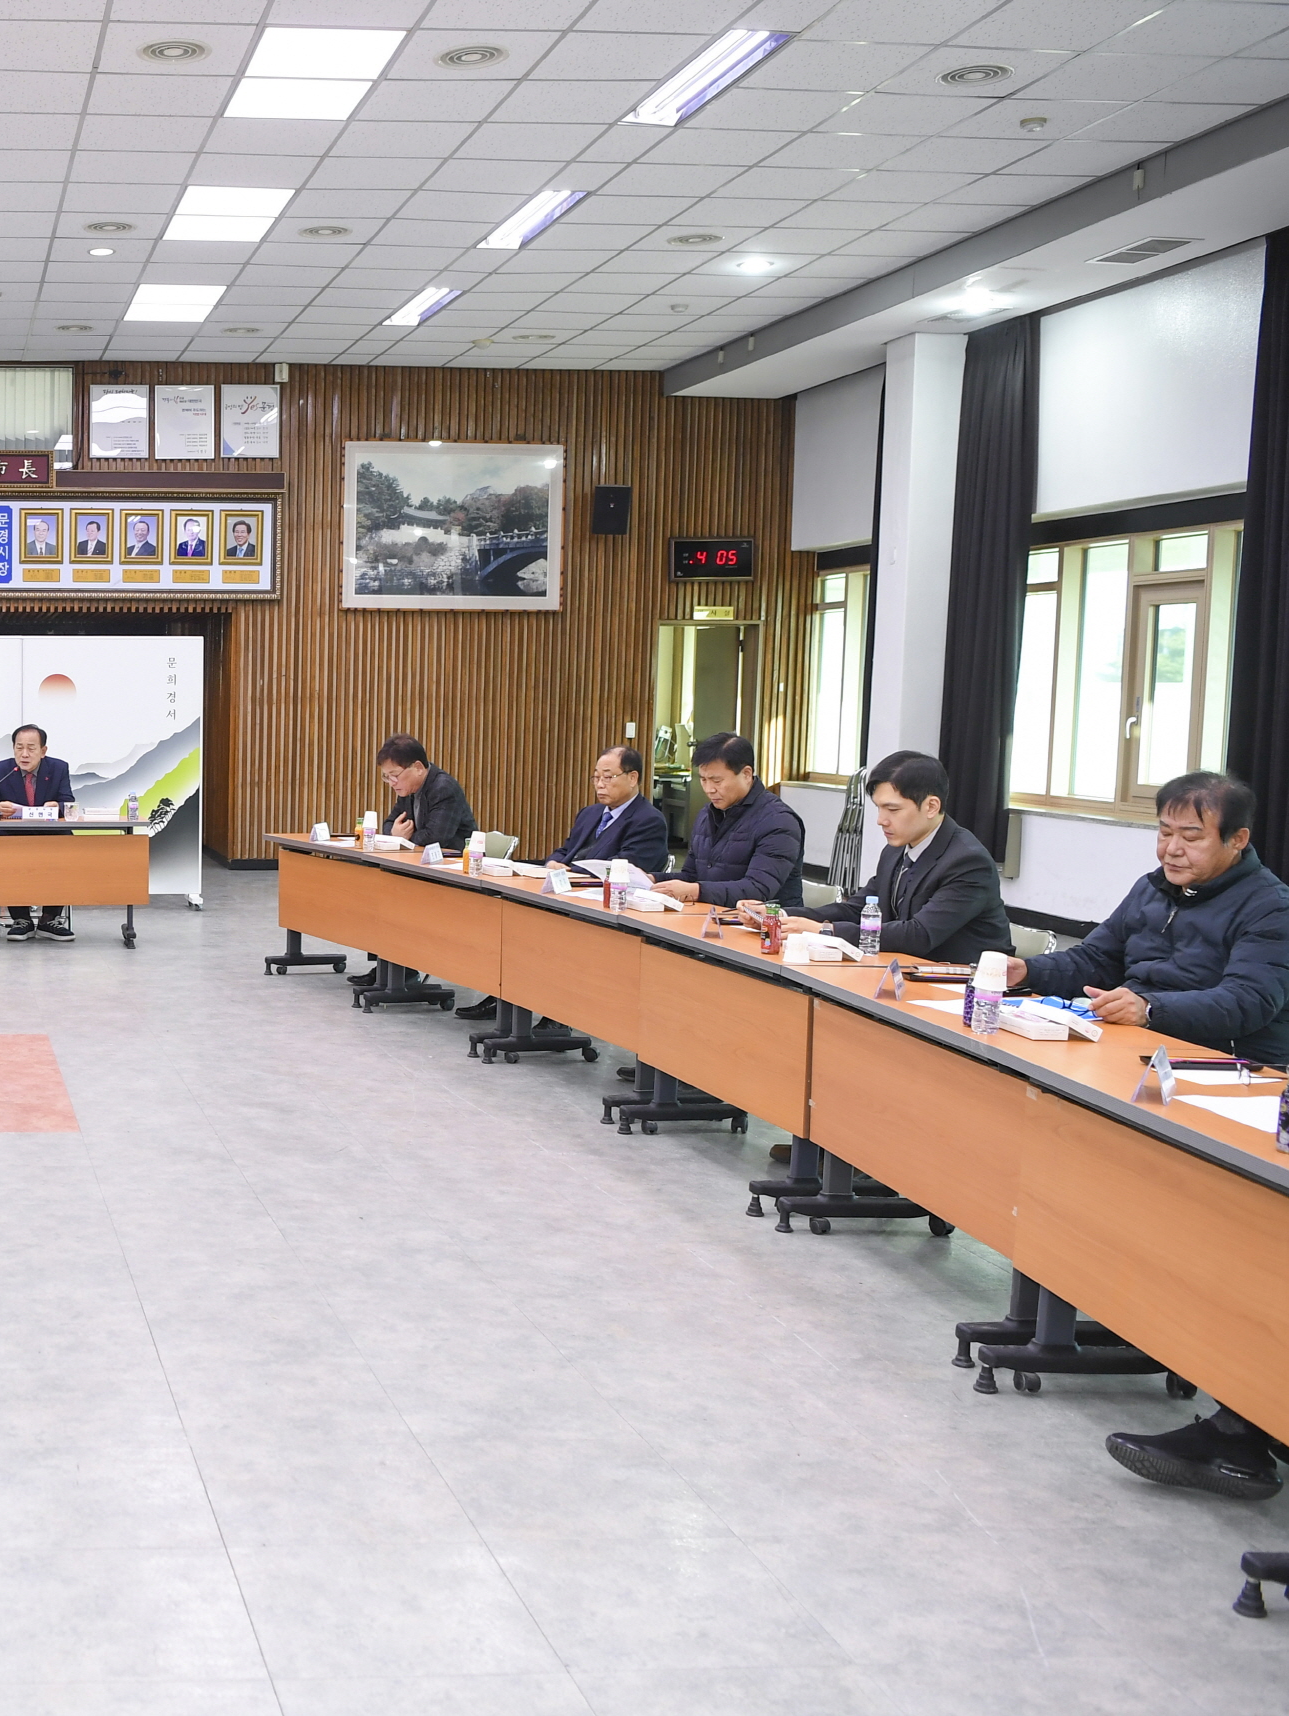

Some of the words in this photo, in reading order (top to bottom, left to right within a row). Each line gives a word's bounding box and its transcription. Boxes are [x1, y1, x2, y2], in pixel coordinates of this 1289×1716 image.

[697, 551, 707, 564] 4
[716, 550, 737, 565] 05
[166, 657, 177, 720] 문희경서
